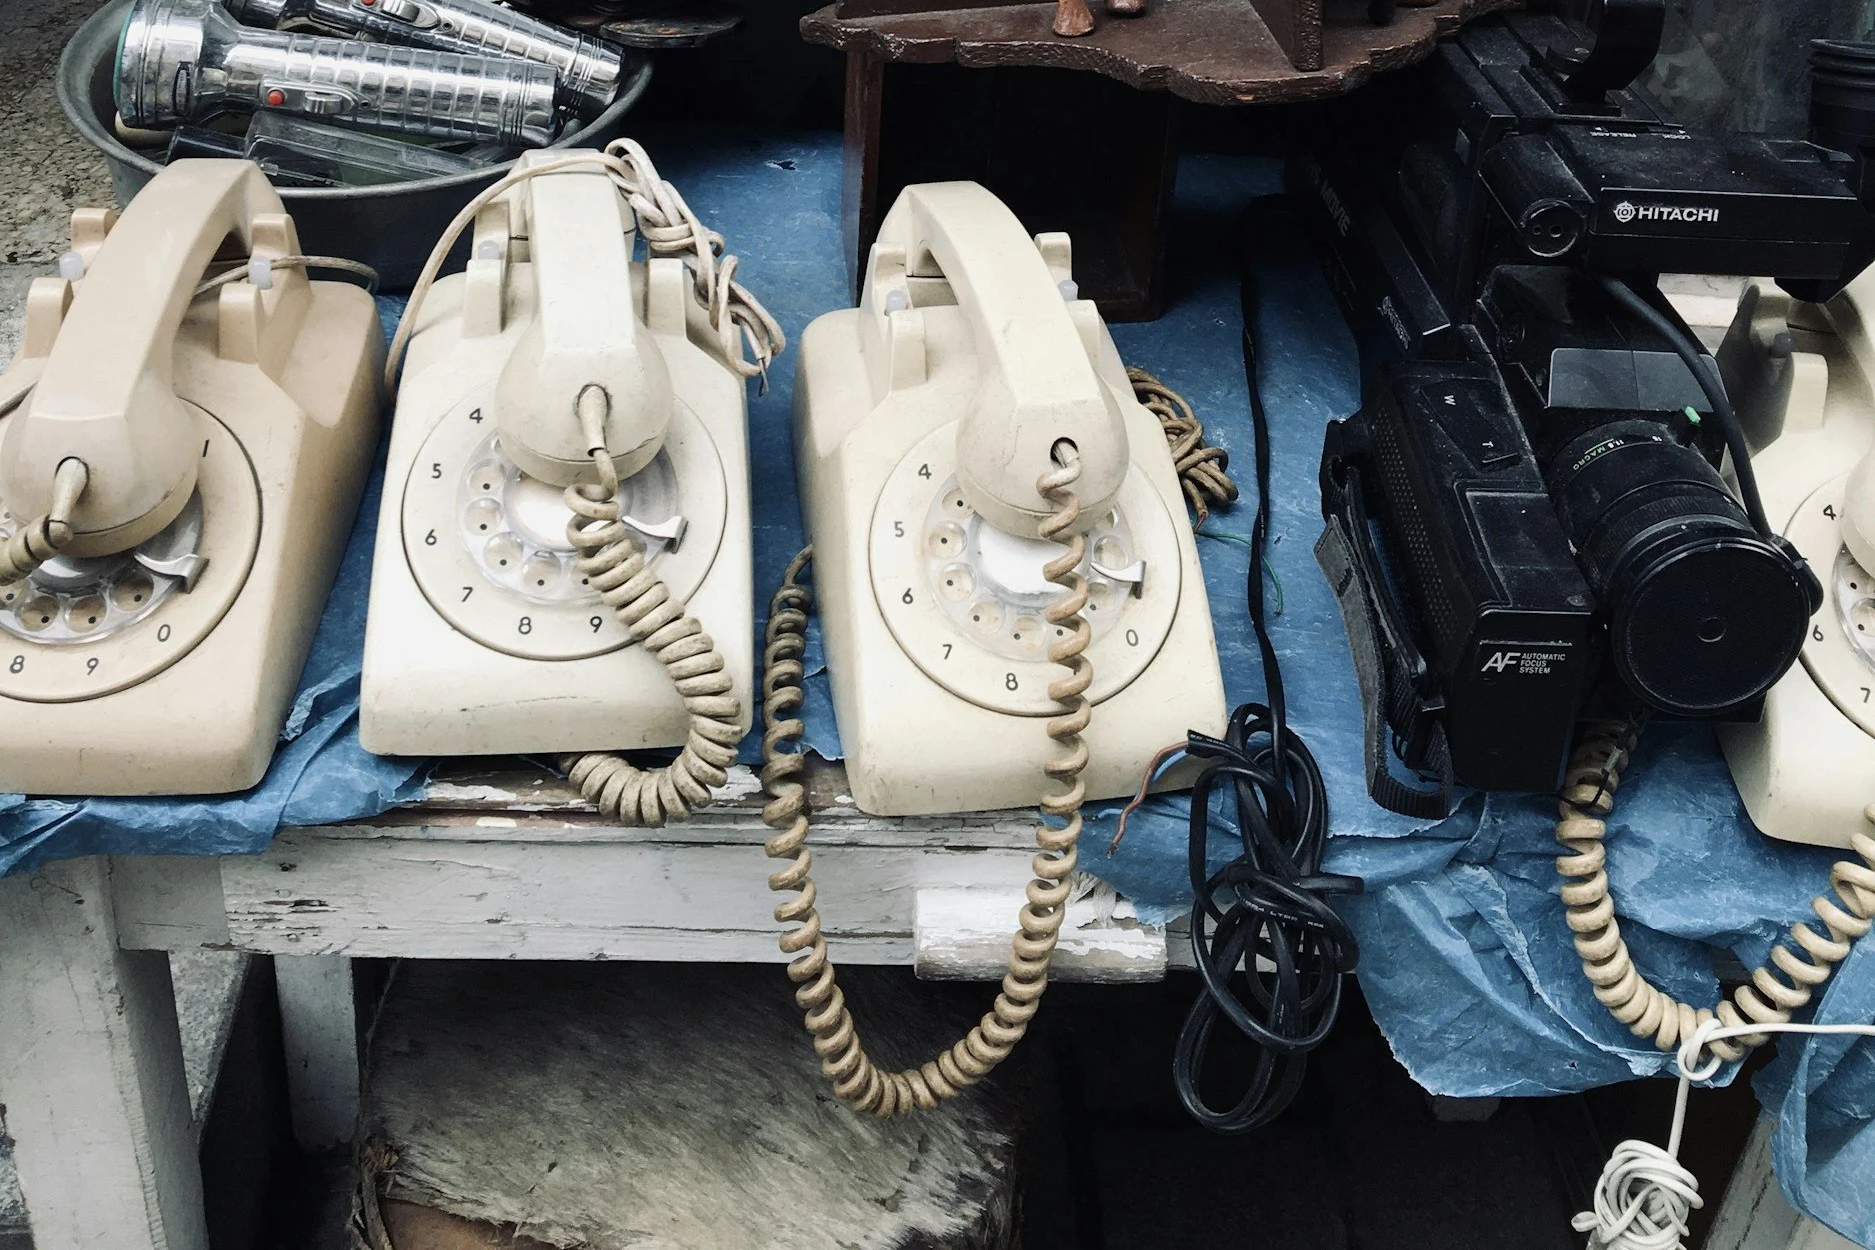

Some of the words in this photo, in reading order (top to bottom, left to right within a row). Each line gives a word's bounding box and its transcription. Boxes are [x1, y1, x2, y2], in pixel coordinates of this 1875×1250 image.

[1638, 206, 1720, 222] HITACHI
[1443, 394, 1457, 406] W
[469, 407, 484, 424] 4
[202, 438, 211, 459] 1
[1481, 440, 1495, 449] T
[1572, 445, 1606, 471] MACRO
[431, 463, 442, 480] 5
[918, 463, 932, 480] 4
[1822, 504, 1837, 521] 4
[424, 528, 437, 546] 6
[894, 520, 905, 538] 5
[462, 586, 474, 603] 7
[902, 587, 914, 605] 6
[157, 623, 171, 643] 0
[518, 616, 532, 635] 8
[589, 615, 603, 633] 9
[1812, 624, 1824, 642] 6
[1125, 629, 1139, 647] 0
[942, 643, 953, 660] 7
[1521, 652, 1567, 662] AUTOMATIC
[9, 654, 25, 675] 8
[86, 657, 99, 676] 9
[1480, 651, 1522, 673] AF
[1518, 666, 1551, 675] SYSTEM
[1520, 660, 1547, 668] FOCUS
[1005, 672, 1019, 692] 8
[1860, 686, 1871, 704] 7
